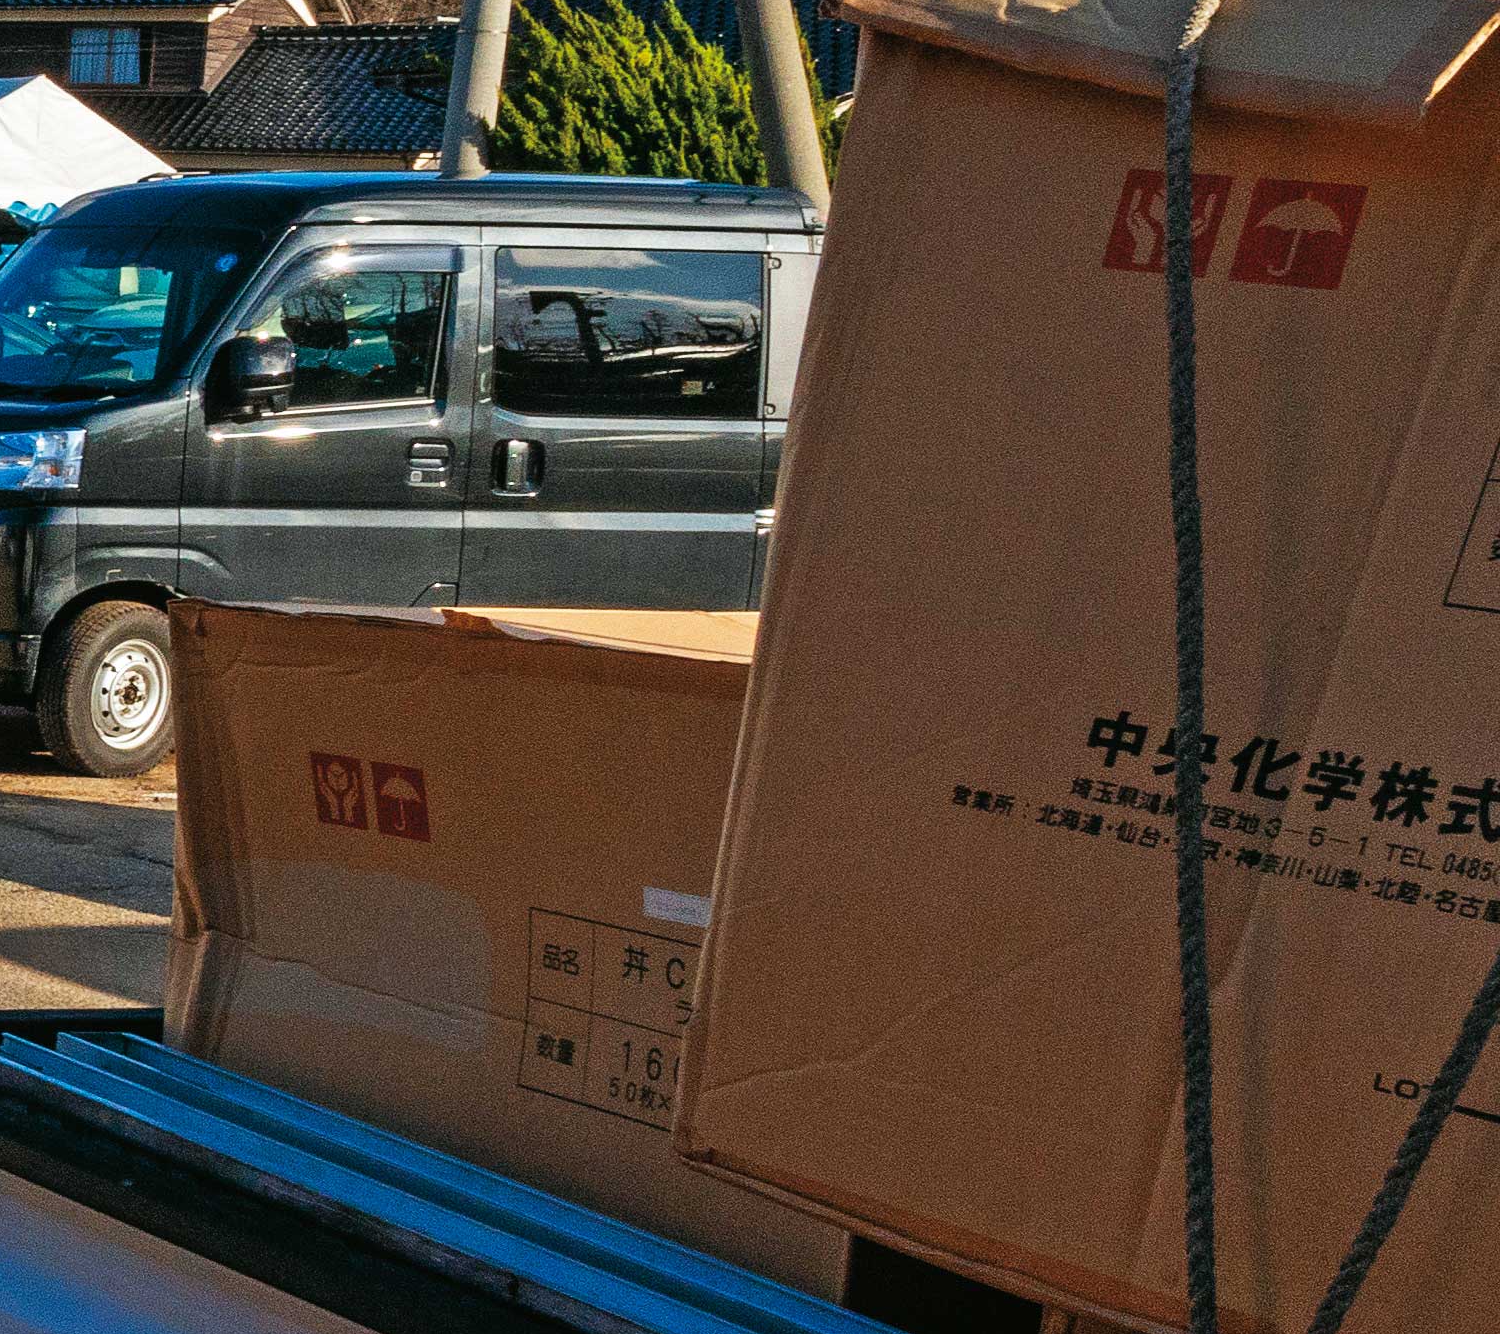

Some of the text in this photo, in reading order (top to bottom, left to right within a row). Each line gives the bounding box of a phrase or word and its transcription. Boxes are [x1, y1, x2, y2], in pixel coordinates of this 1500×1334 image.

[1387, 843, 1434, 873] TEL
[543, 943, 581, 976] 品名
[536, 1032, 576, 1067] 数量
[1372, 1072, 1436, 1100] LO
